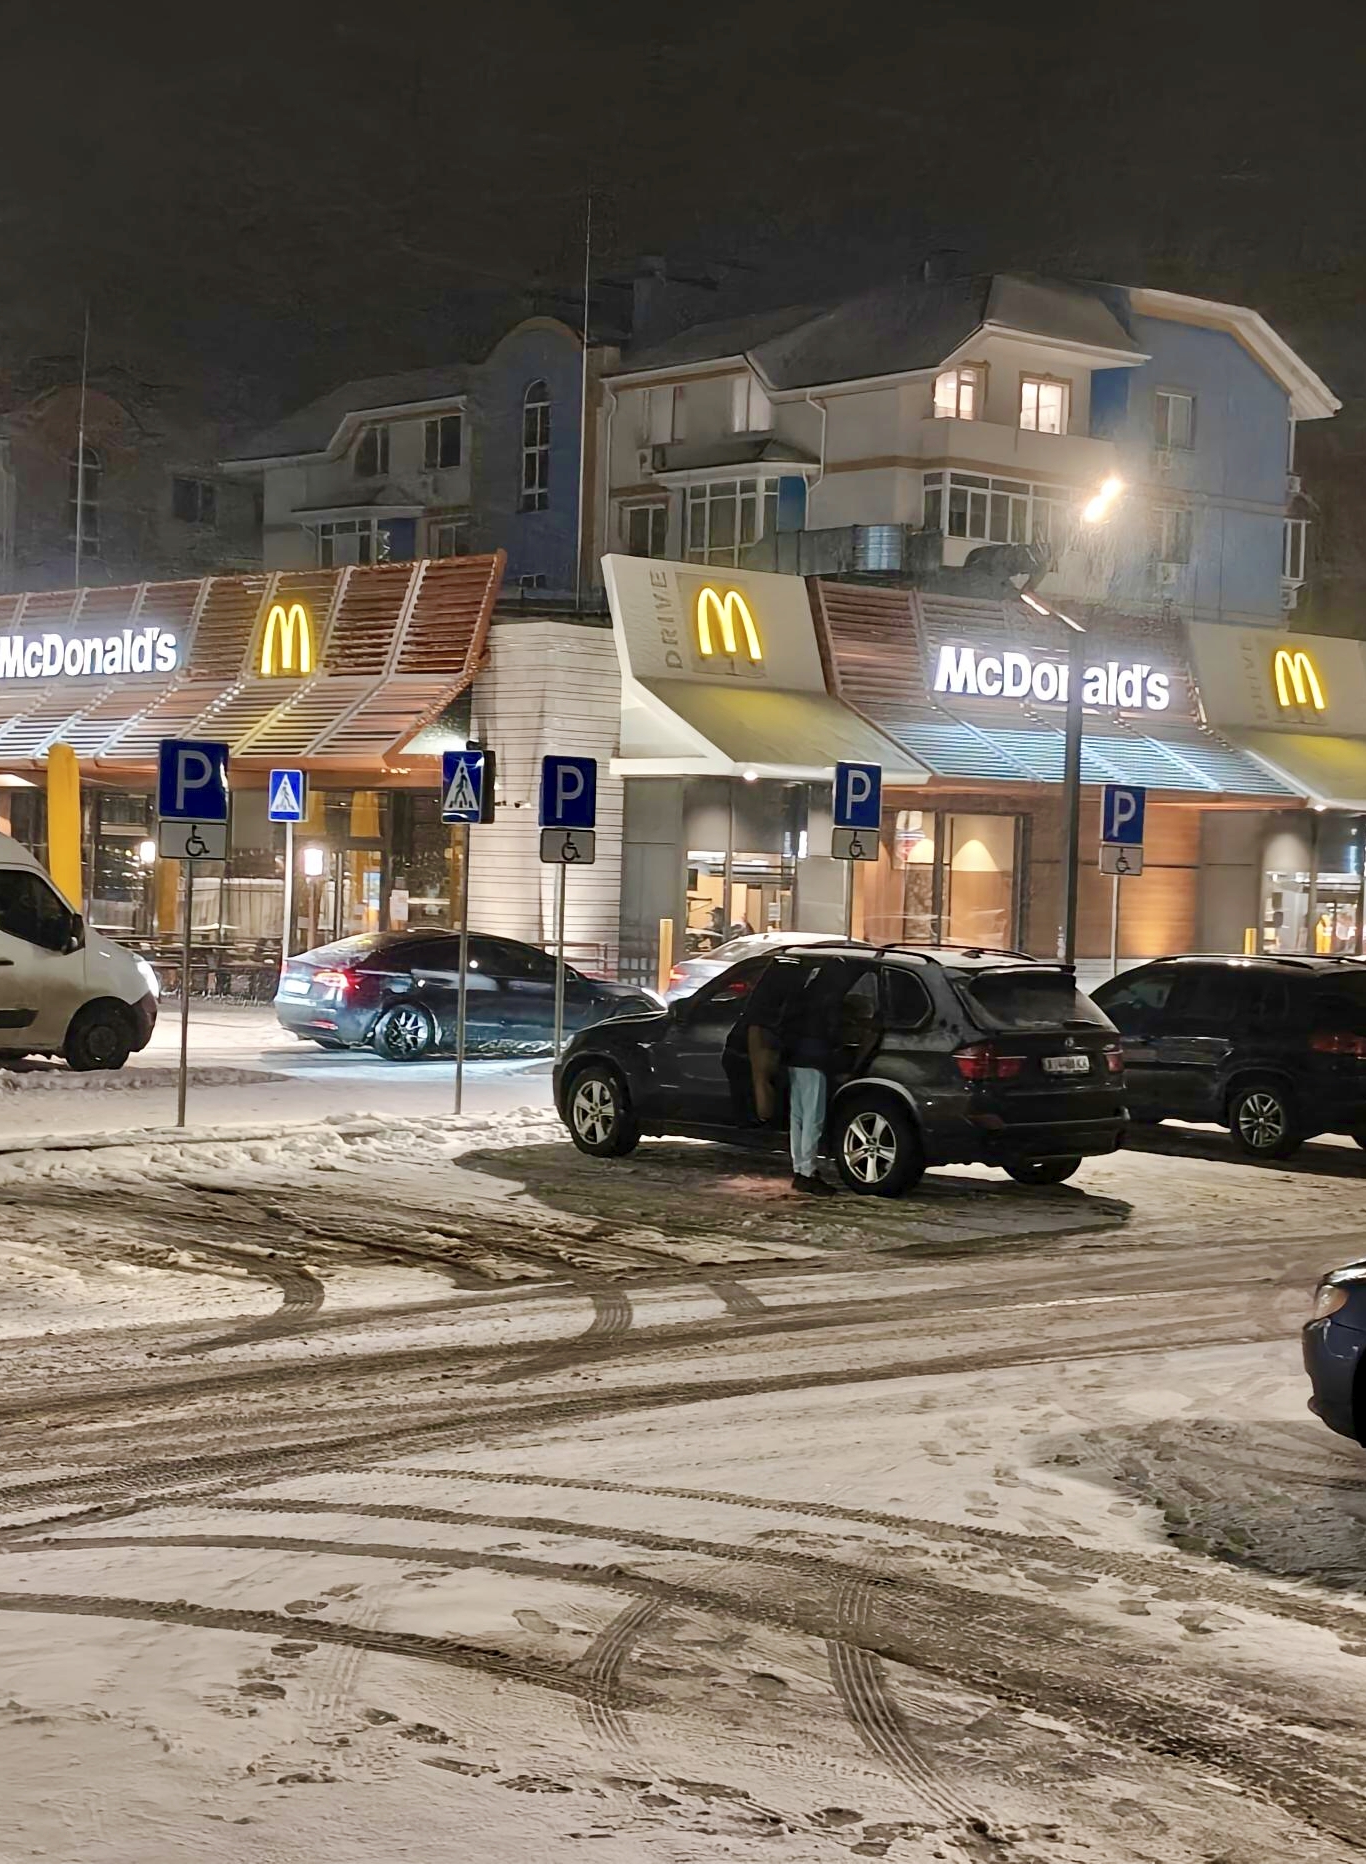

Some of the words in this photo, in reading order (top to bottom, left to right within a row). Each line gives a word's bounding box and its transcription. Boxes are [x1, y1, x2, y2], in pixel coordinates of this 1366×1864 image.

[650, 568, 683, 670] DRIVE
[176, 750, 212, 809] P
[556, 765, 584, 818] P
[846, 770, 871, 819] P
[1112, 791, 1136, 837] P
